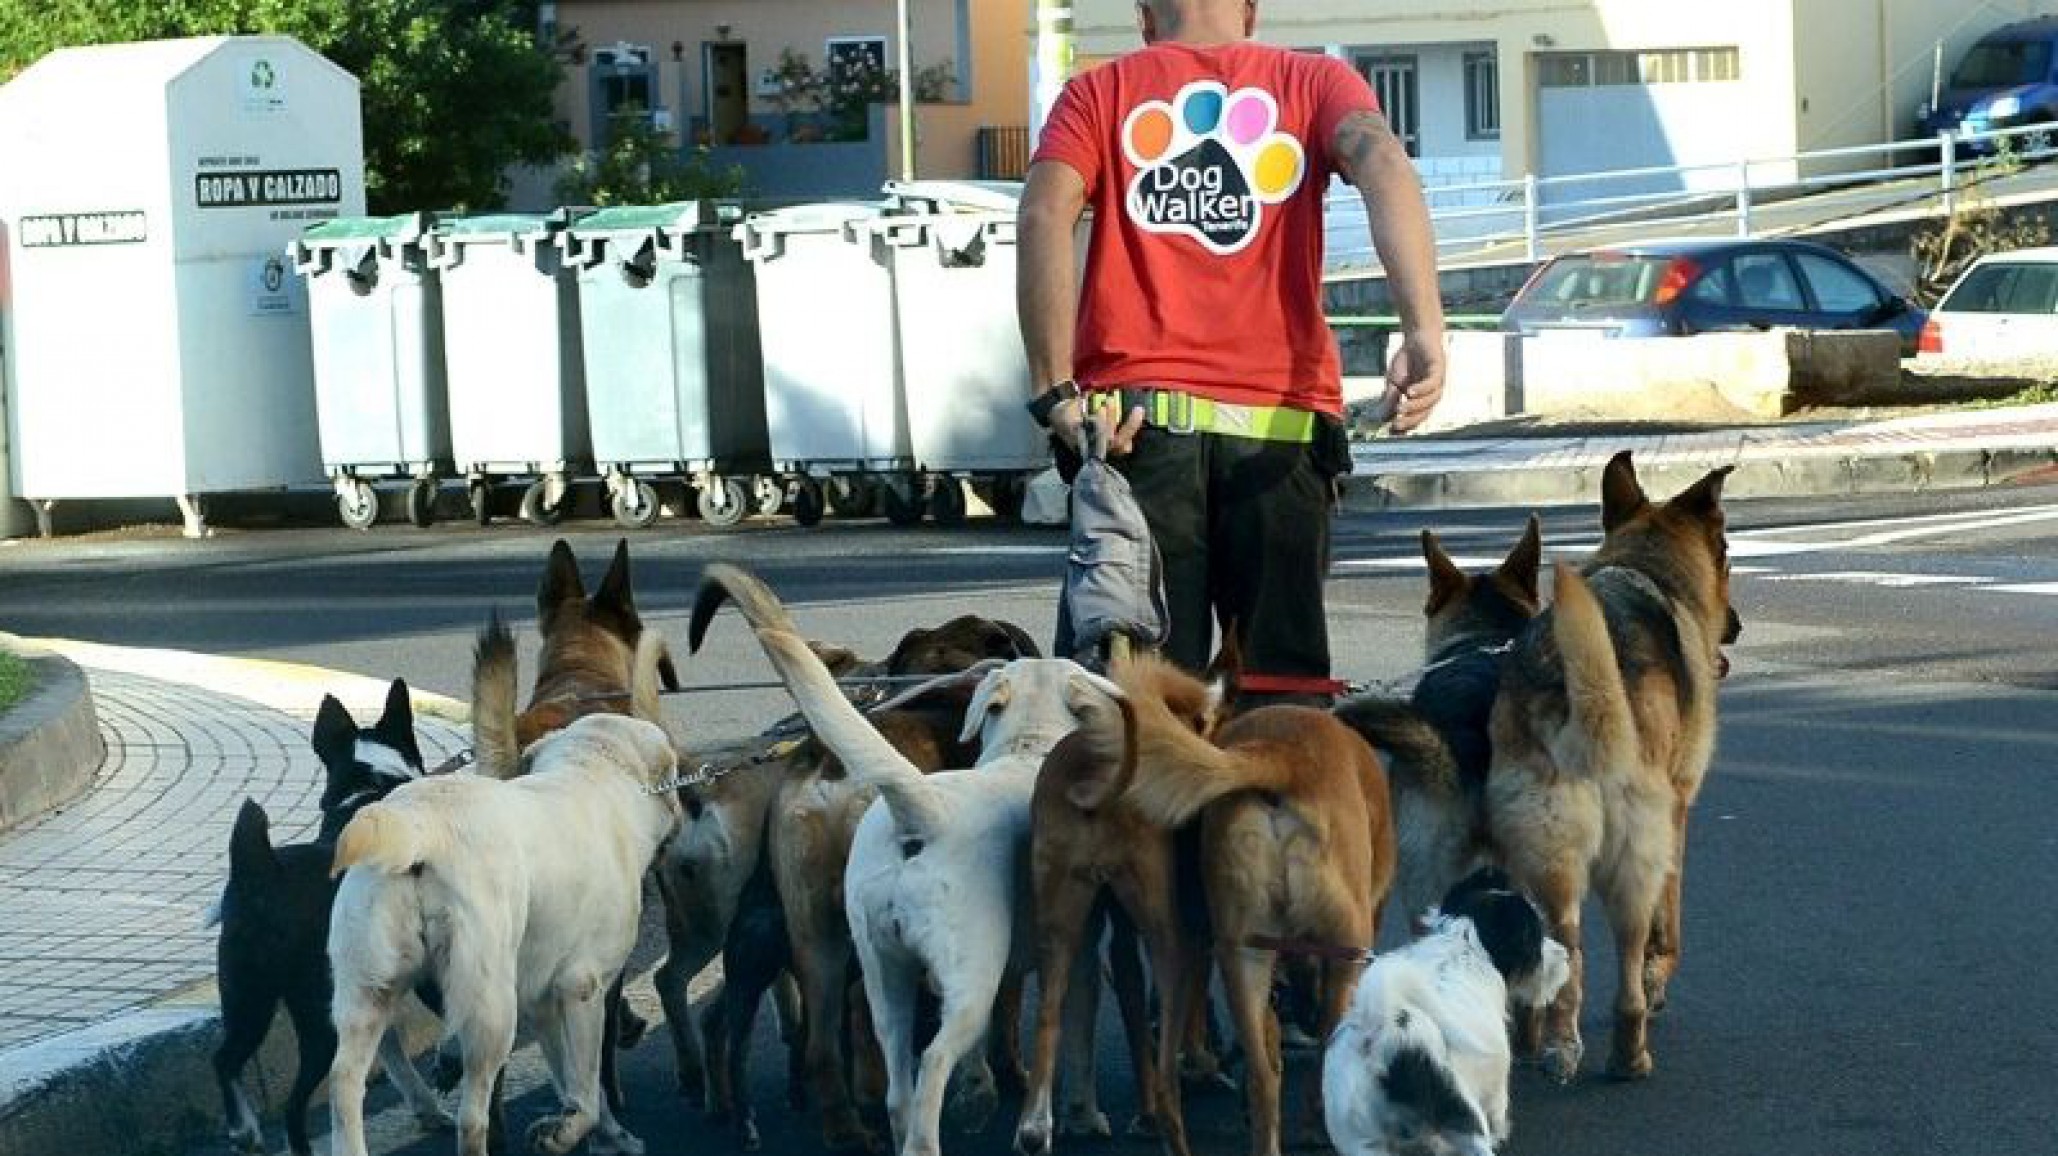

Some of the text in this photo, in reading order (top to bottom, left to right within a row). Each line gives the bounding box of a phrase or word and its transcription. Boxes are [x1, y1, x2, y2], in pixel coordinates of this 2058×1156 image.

[200, 174, 339, 202] ROPA Y CALZADO
[1154, 164, 1222, 193] Dog
[1134, 189, 1253, 222] Walker
